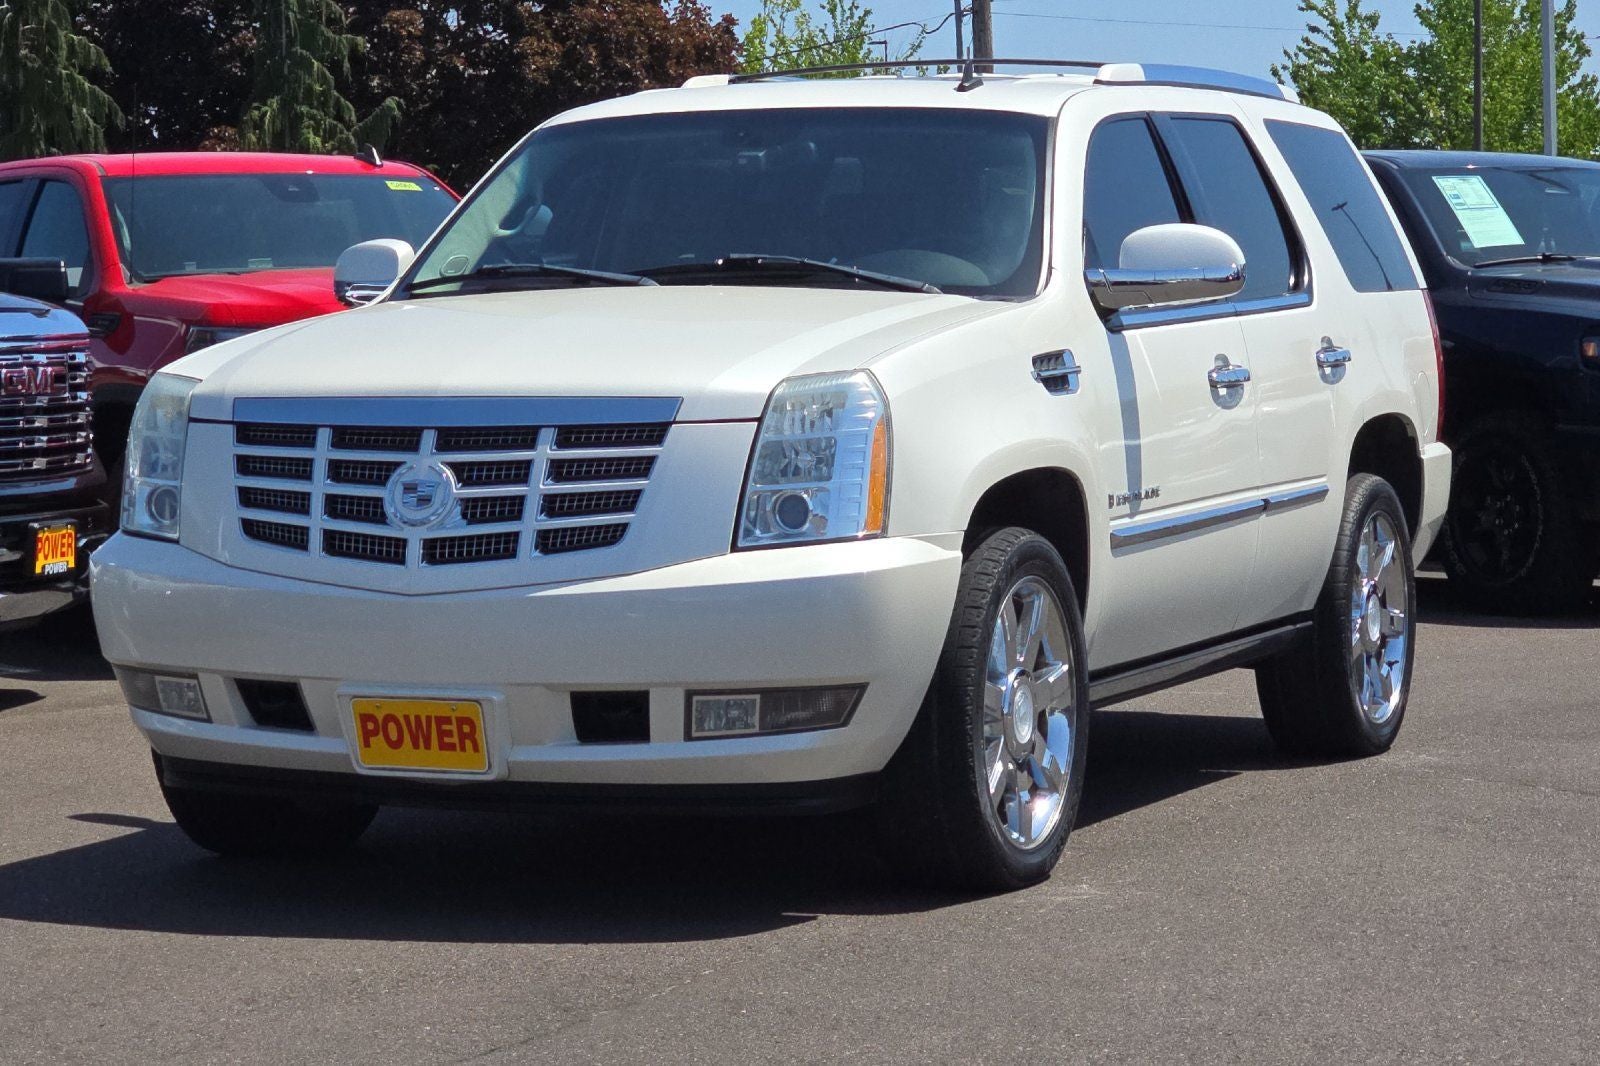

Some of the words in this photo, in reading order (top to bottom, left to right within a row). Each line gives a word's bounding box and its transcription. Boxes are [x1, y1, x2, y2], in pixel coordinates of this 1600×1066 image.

[1, 366, 67, 394] GMC
[37, 532, 74, 560] POWER
[44, 562, 68, 575] POWER
[359, 713, 480, 753] POWER
